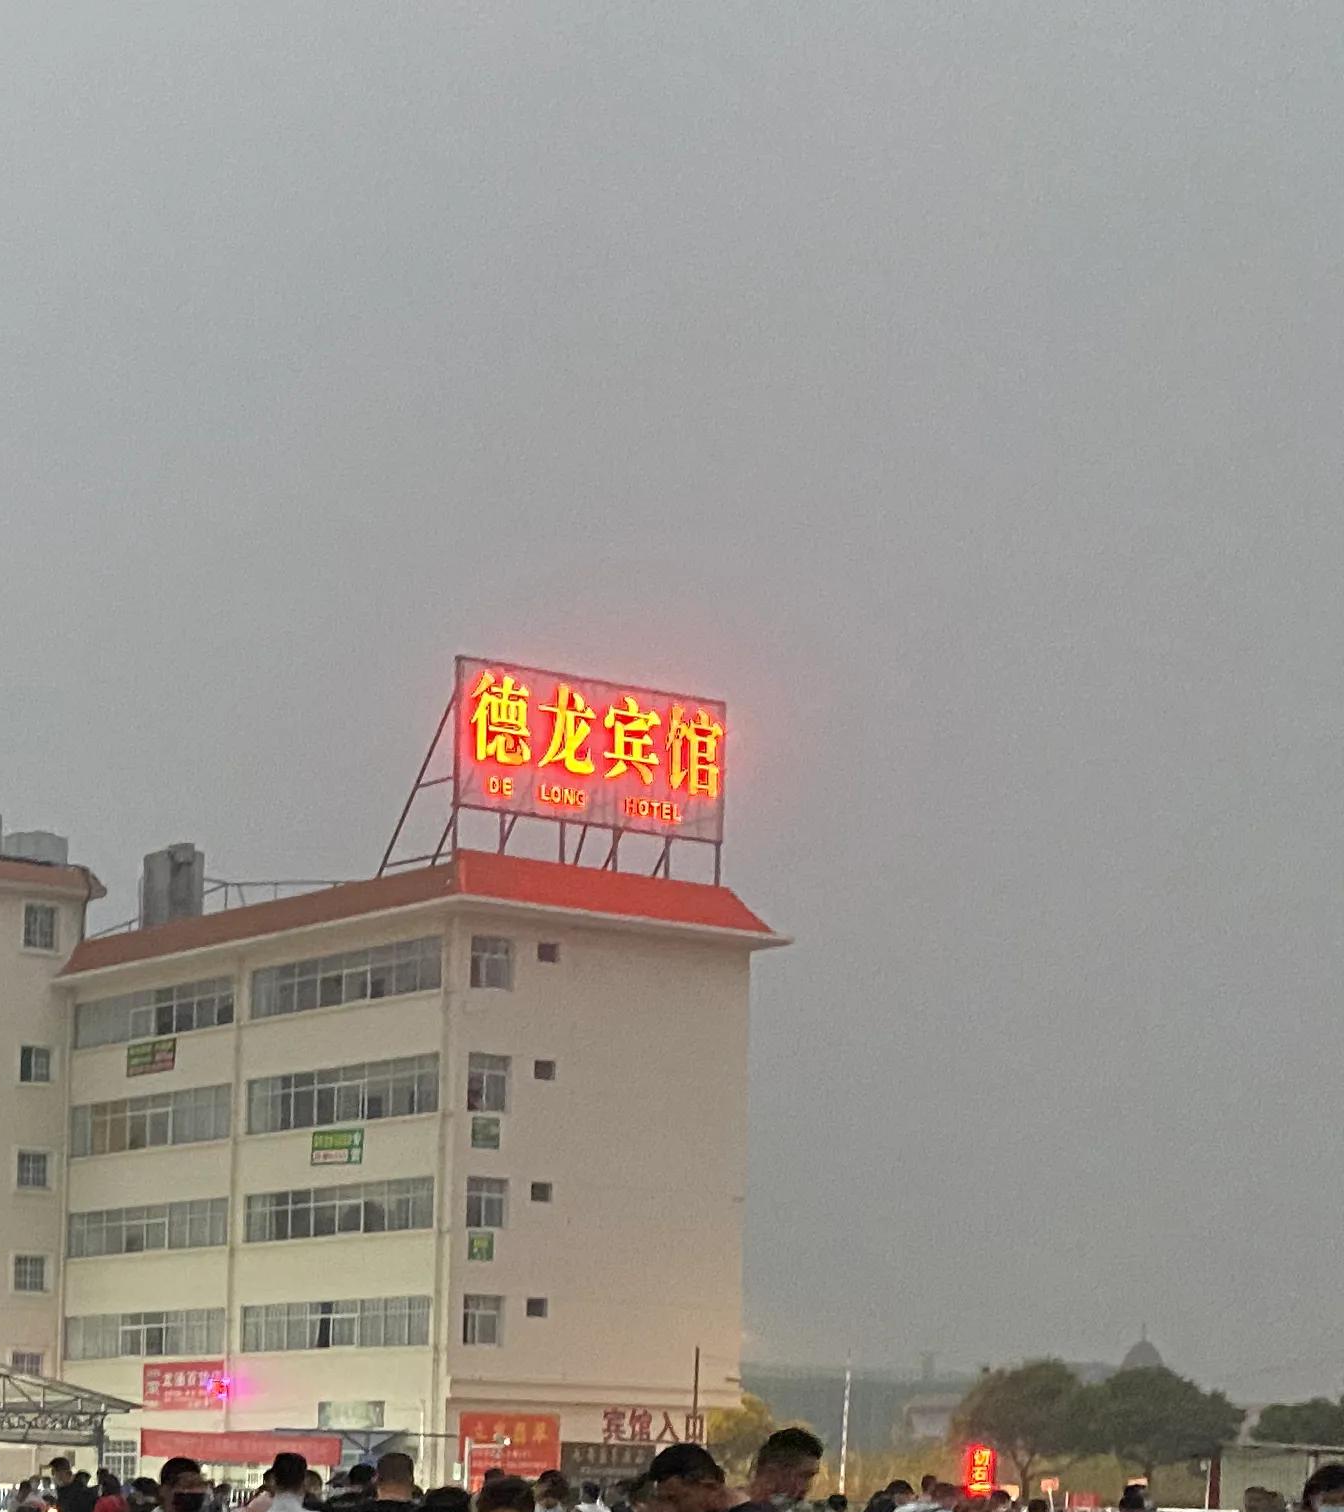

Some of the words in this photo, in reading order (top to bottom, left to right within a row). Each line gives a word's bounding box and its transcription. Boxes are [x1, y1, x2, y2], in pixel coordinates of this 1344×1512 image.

[469, 671, 724, 798] 德龙宾馆
[489, 775, 513, 797] DE
[539, 784, 587, 808] LONG
[625, 797, 683, 822] HOTEL
[602, 1406, 704, 1442] 宾馆入口
